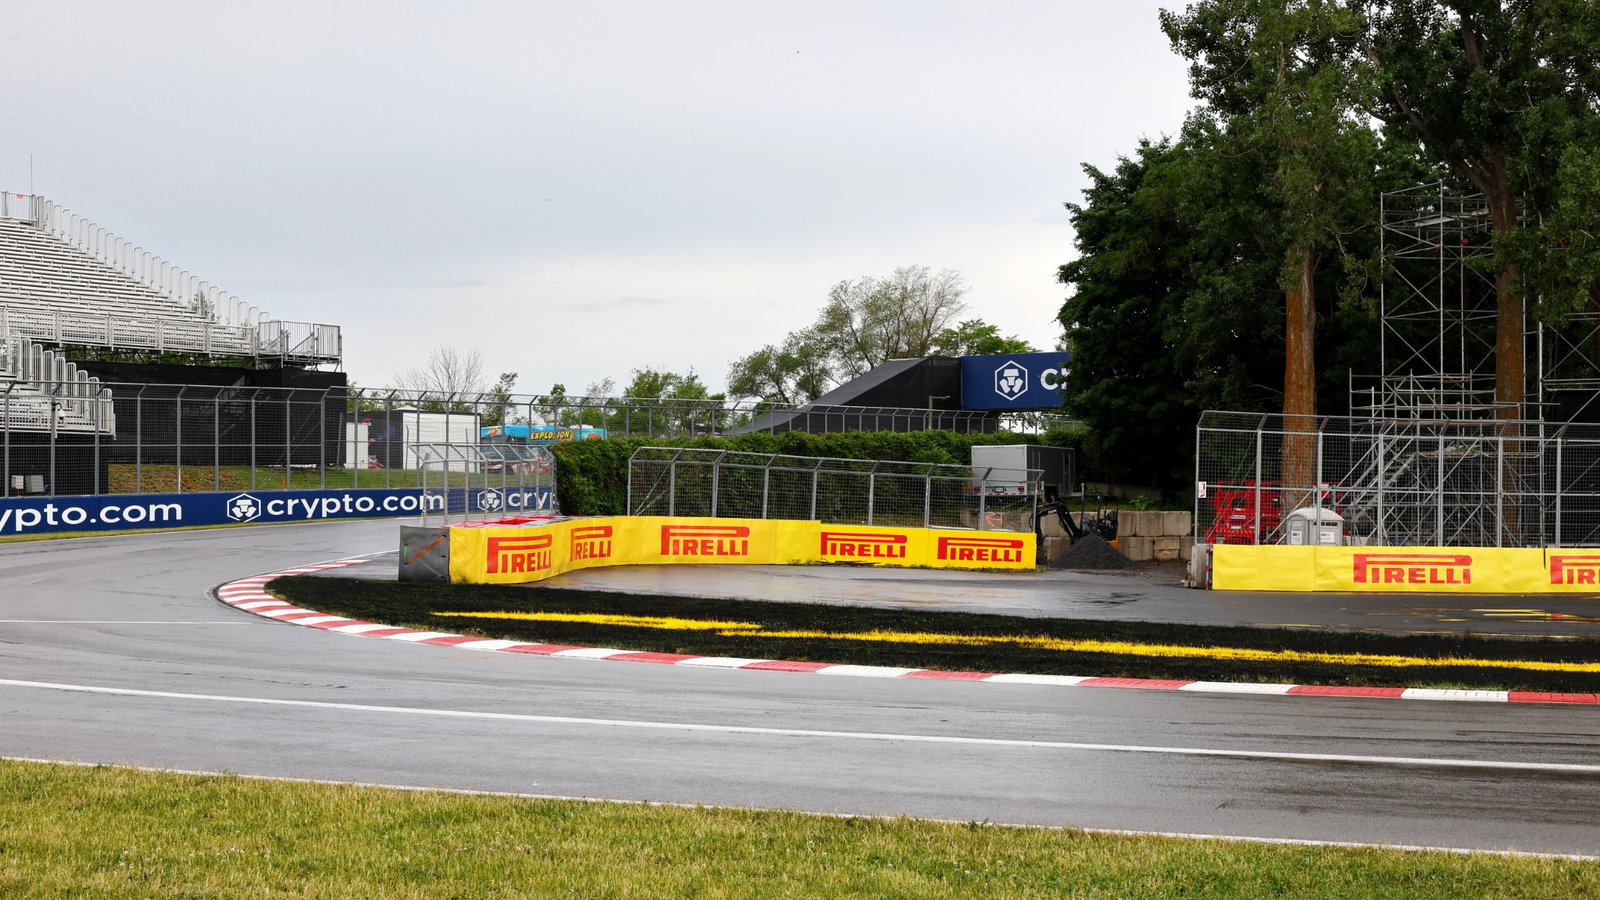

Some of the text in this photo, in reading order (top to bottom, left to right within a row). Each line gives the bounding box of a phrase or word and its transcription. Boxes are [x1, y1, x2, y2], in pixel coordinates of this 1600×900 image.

[531, 431, 571, 440] EXPLOION
[266, 494, 444, 519] crypto.com
[487, 533, 553, 574] PIRELLI
[661, 525, 750, 556] PIRELLI
[820, 532, 908, 558] PIRELLI
[937, 536, 1024, 563] PIRELLI
[1353, 554, 1472, 585] PIRELLI
